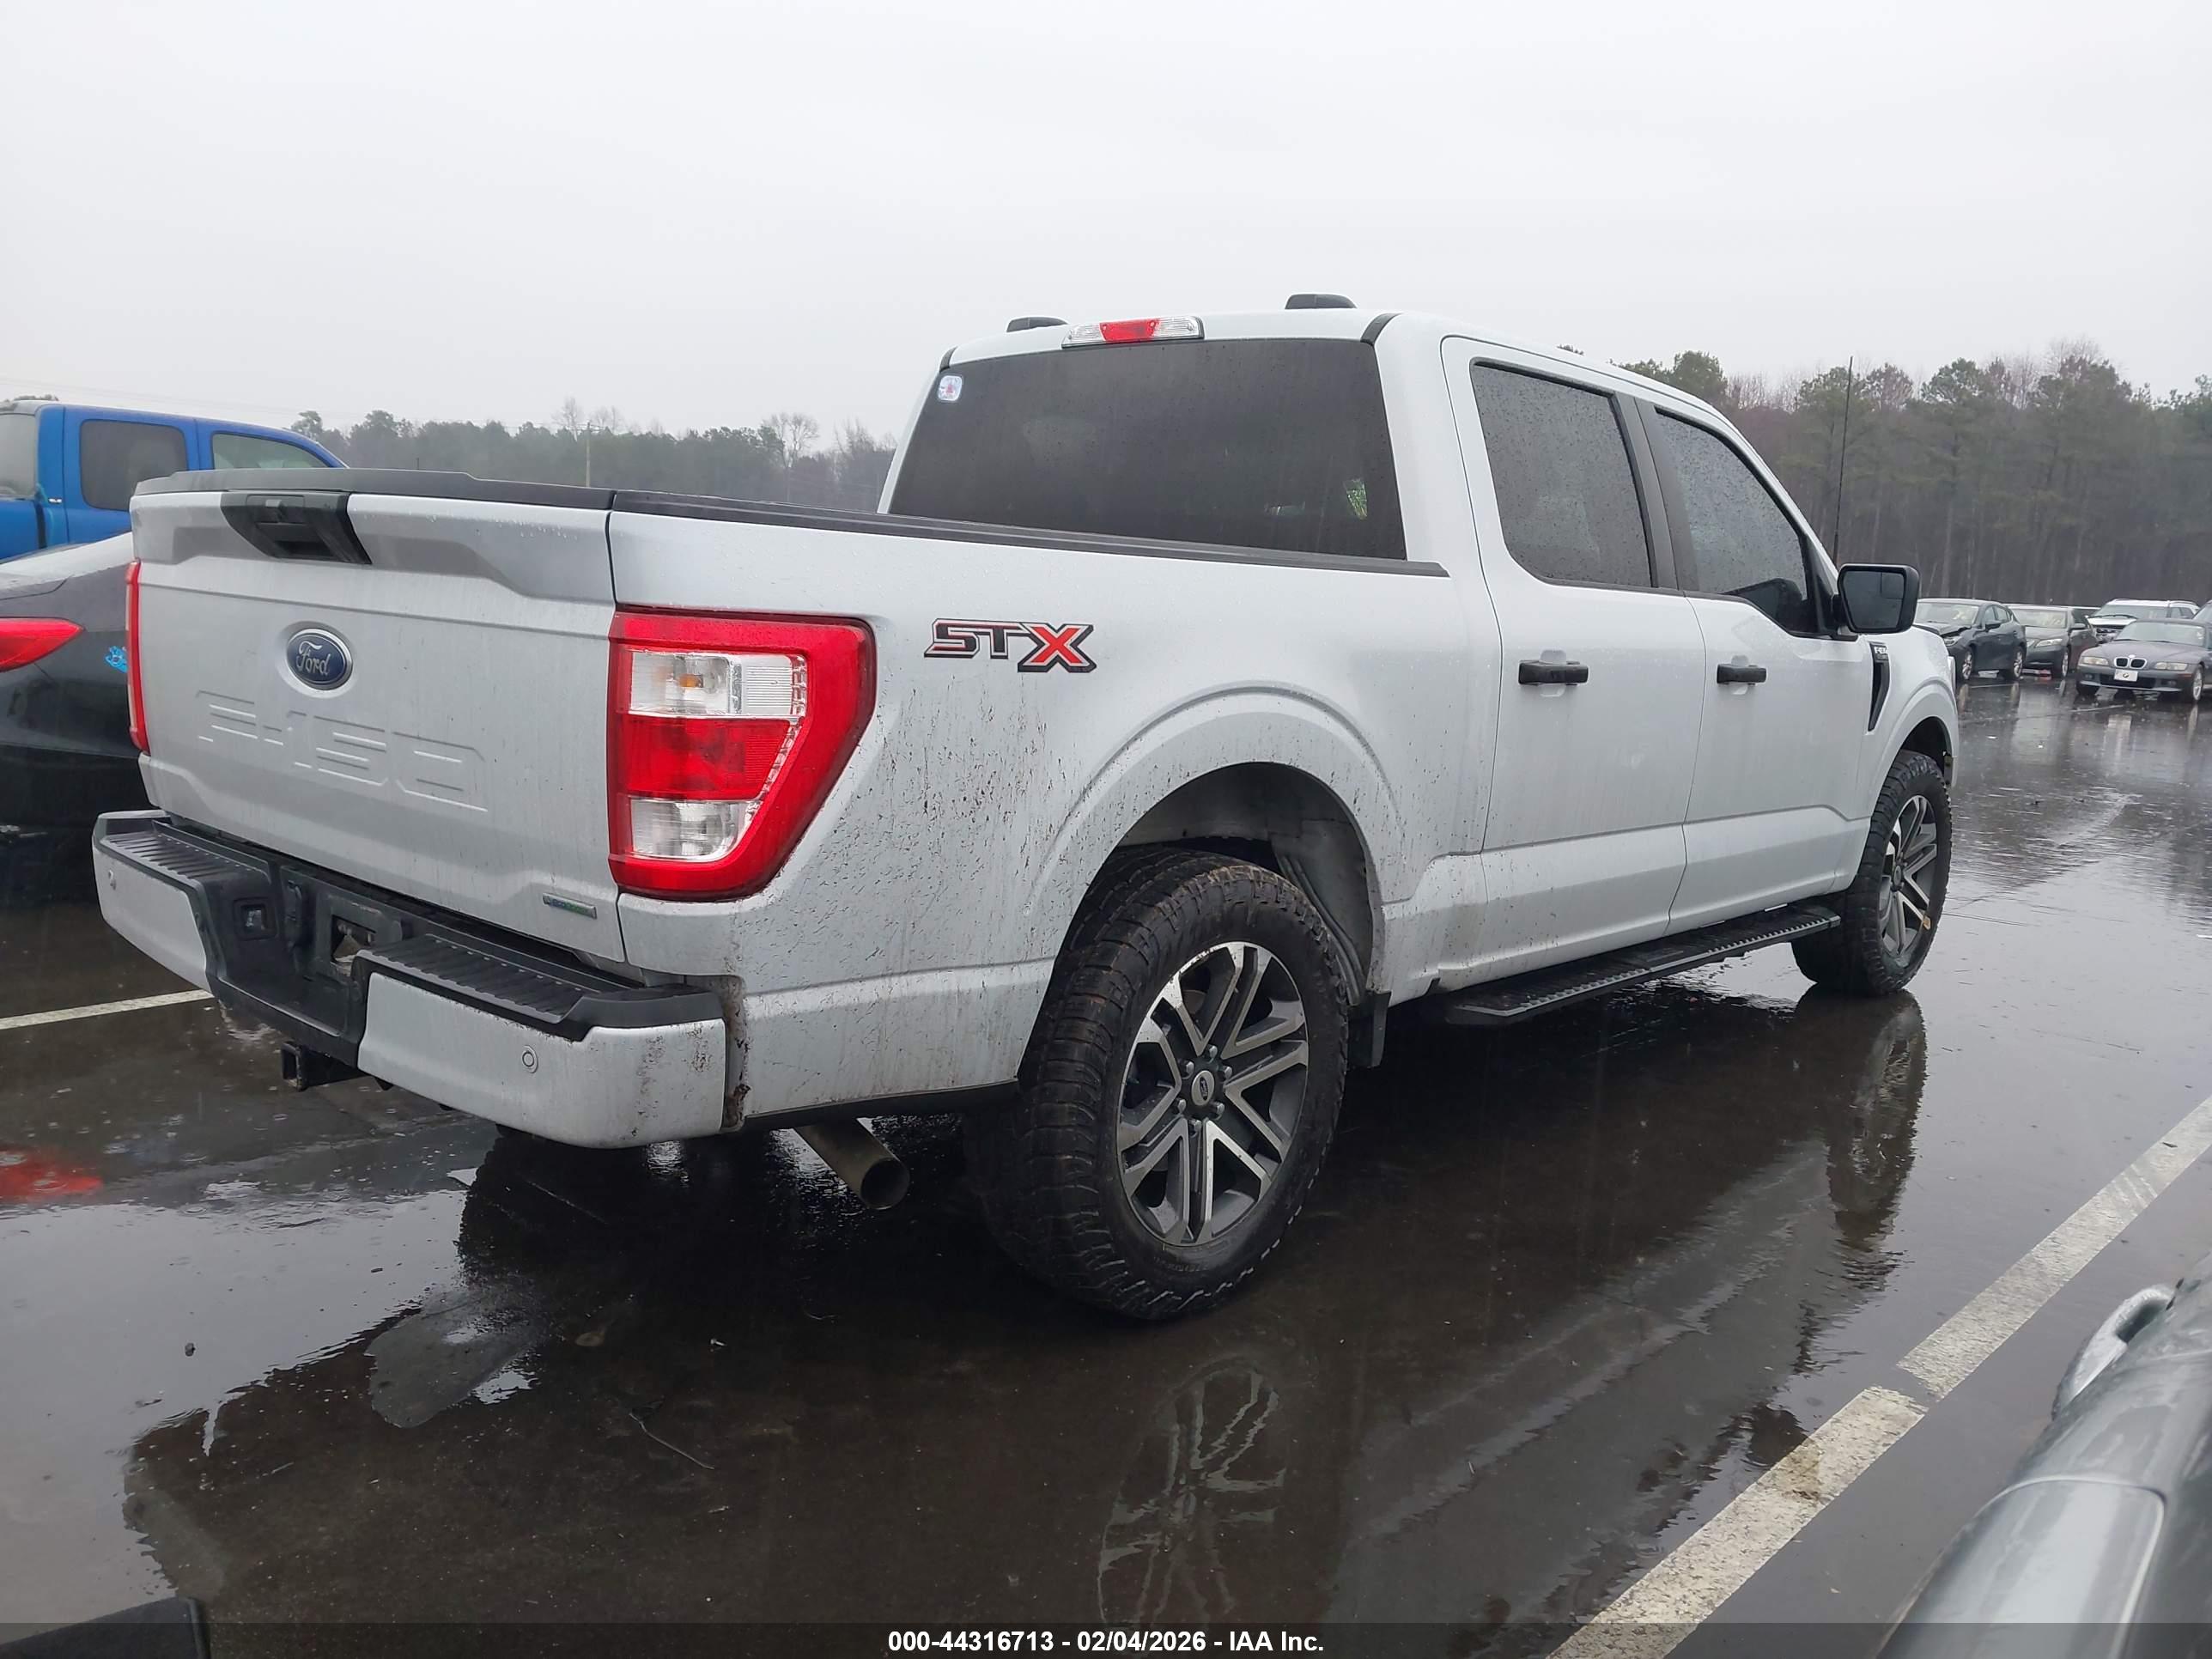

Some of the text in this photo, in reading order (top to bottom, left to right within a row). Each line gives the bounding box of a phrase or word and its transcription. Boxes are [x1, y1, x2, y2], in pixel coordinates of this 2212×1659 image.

[295, 640, 331, 676] Ford
[924, 618, 1097, 672] STX
[196, 690, 488, 811] F-150
